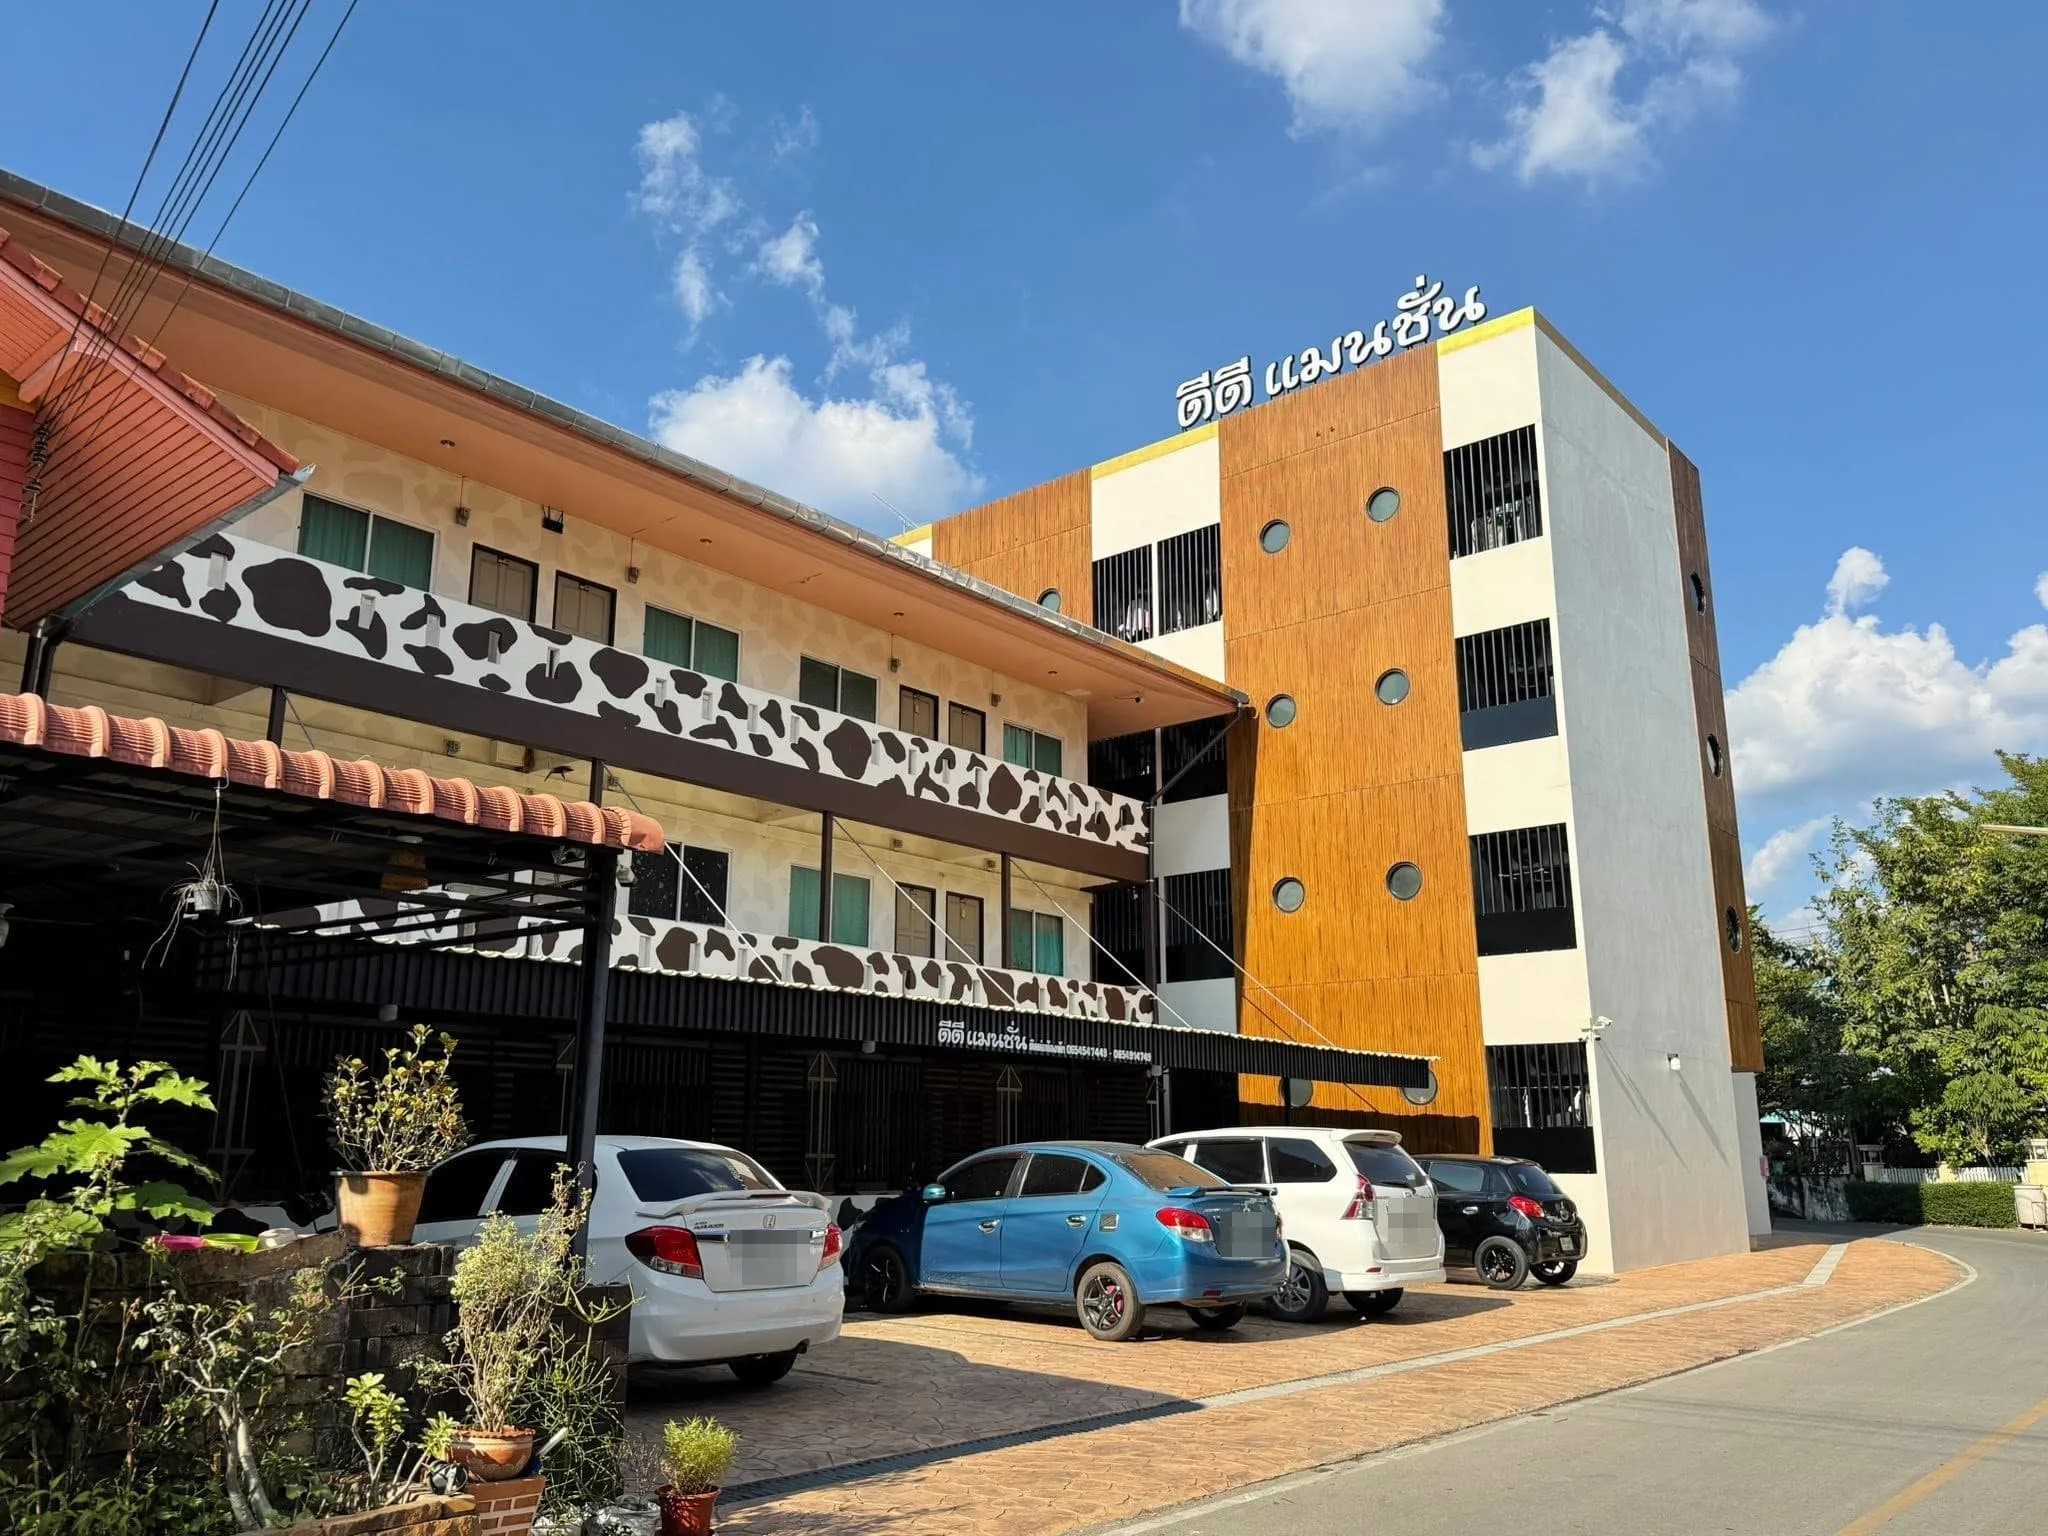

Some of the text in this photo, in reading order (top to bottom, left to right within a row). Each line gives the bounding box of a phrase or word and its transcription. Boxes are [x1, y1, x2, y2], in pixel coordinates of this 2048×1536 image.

[1176, 273, 1487, 428] ดีดี แมนชั่น
[938, 1020, 965, 1045] ดีดี
[967, 1020, 1028, 1051] แมนชั่น
